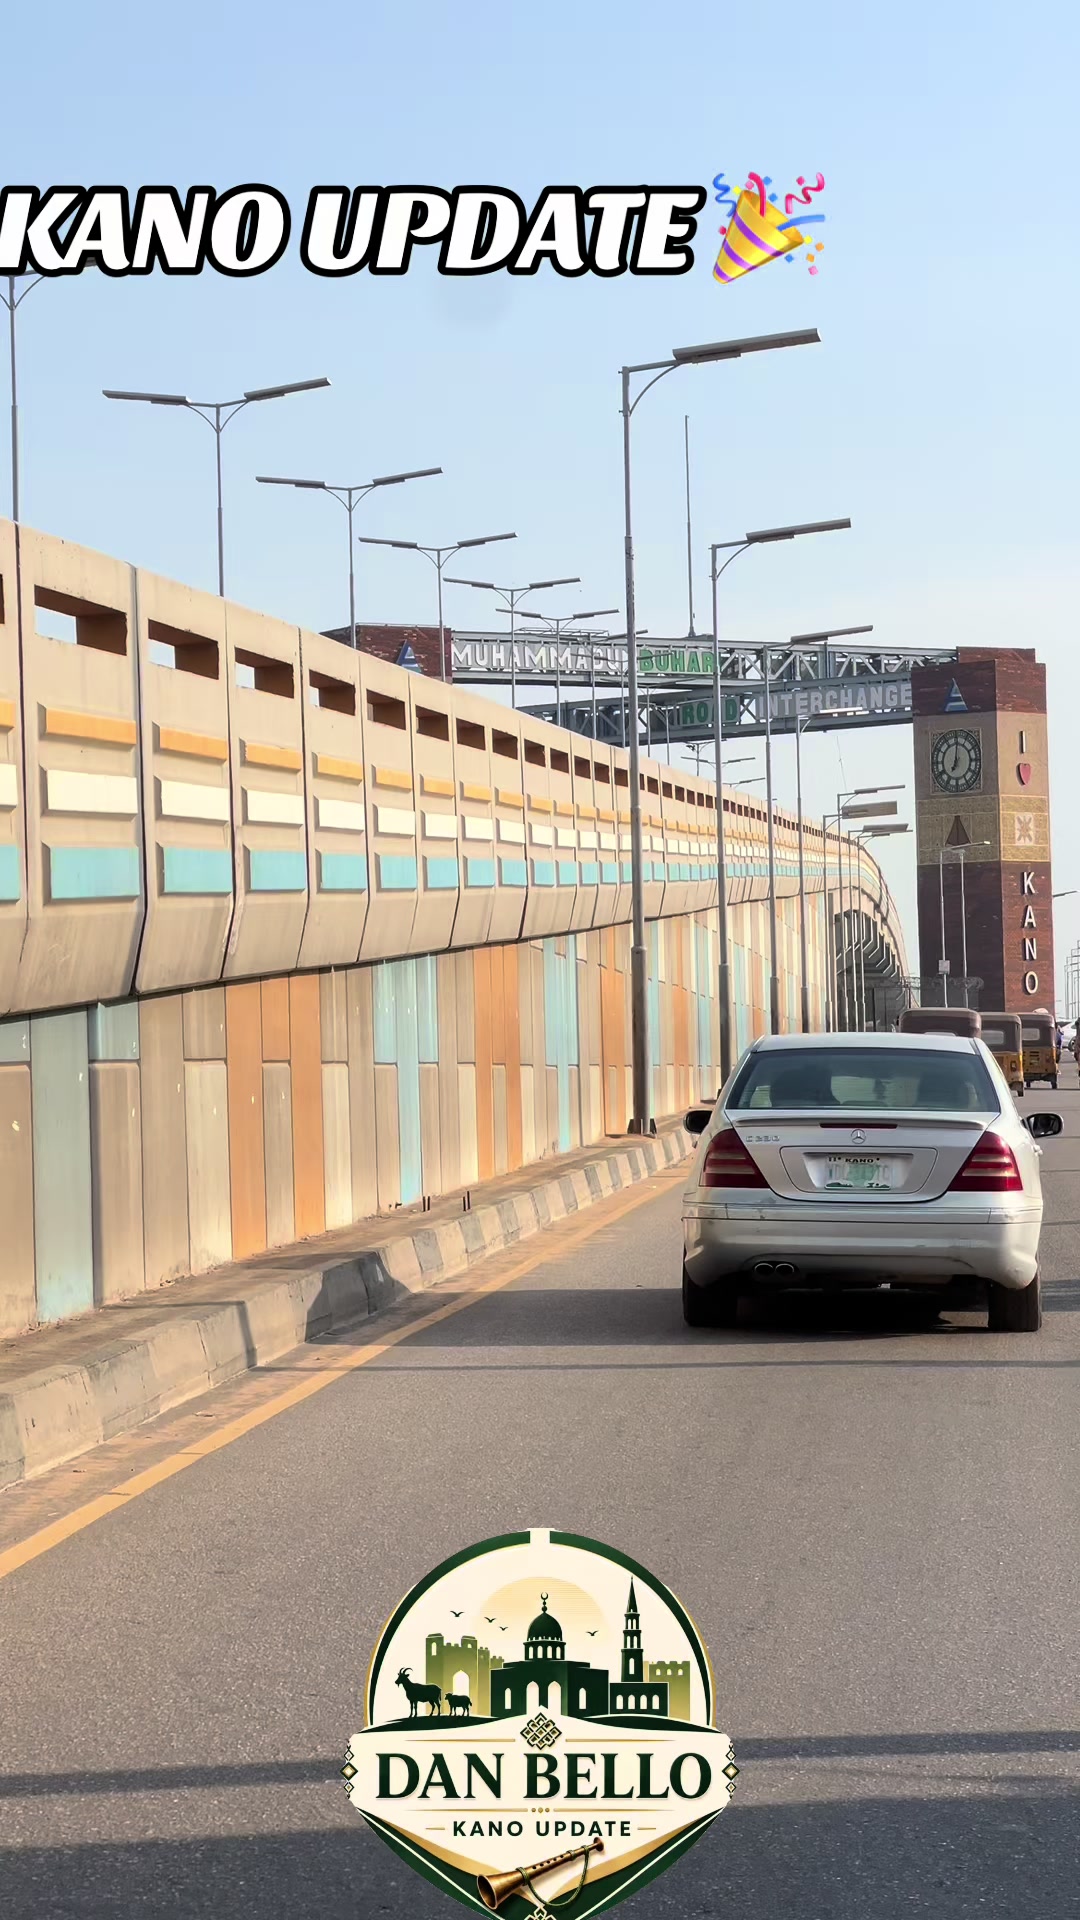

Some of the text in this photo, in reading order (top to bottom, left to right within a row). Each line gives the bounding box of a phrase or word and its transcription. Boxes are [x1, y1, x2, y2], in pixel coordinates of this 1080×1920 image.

[452, 643, 718, 673] MUHAMMADU BUHAR
[682, 683, 913, 725] ROD INTERCHANGE
[1019, 730, 1026, 754] I
[1021, 871, 1040, 996] KANO
